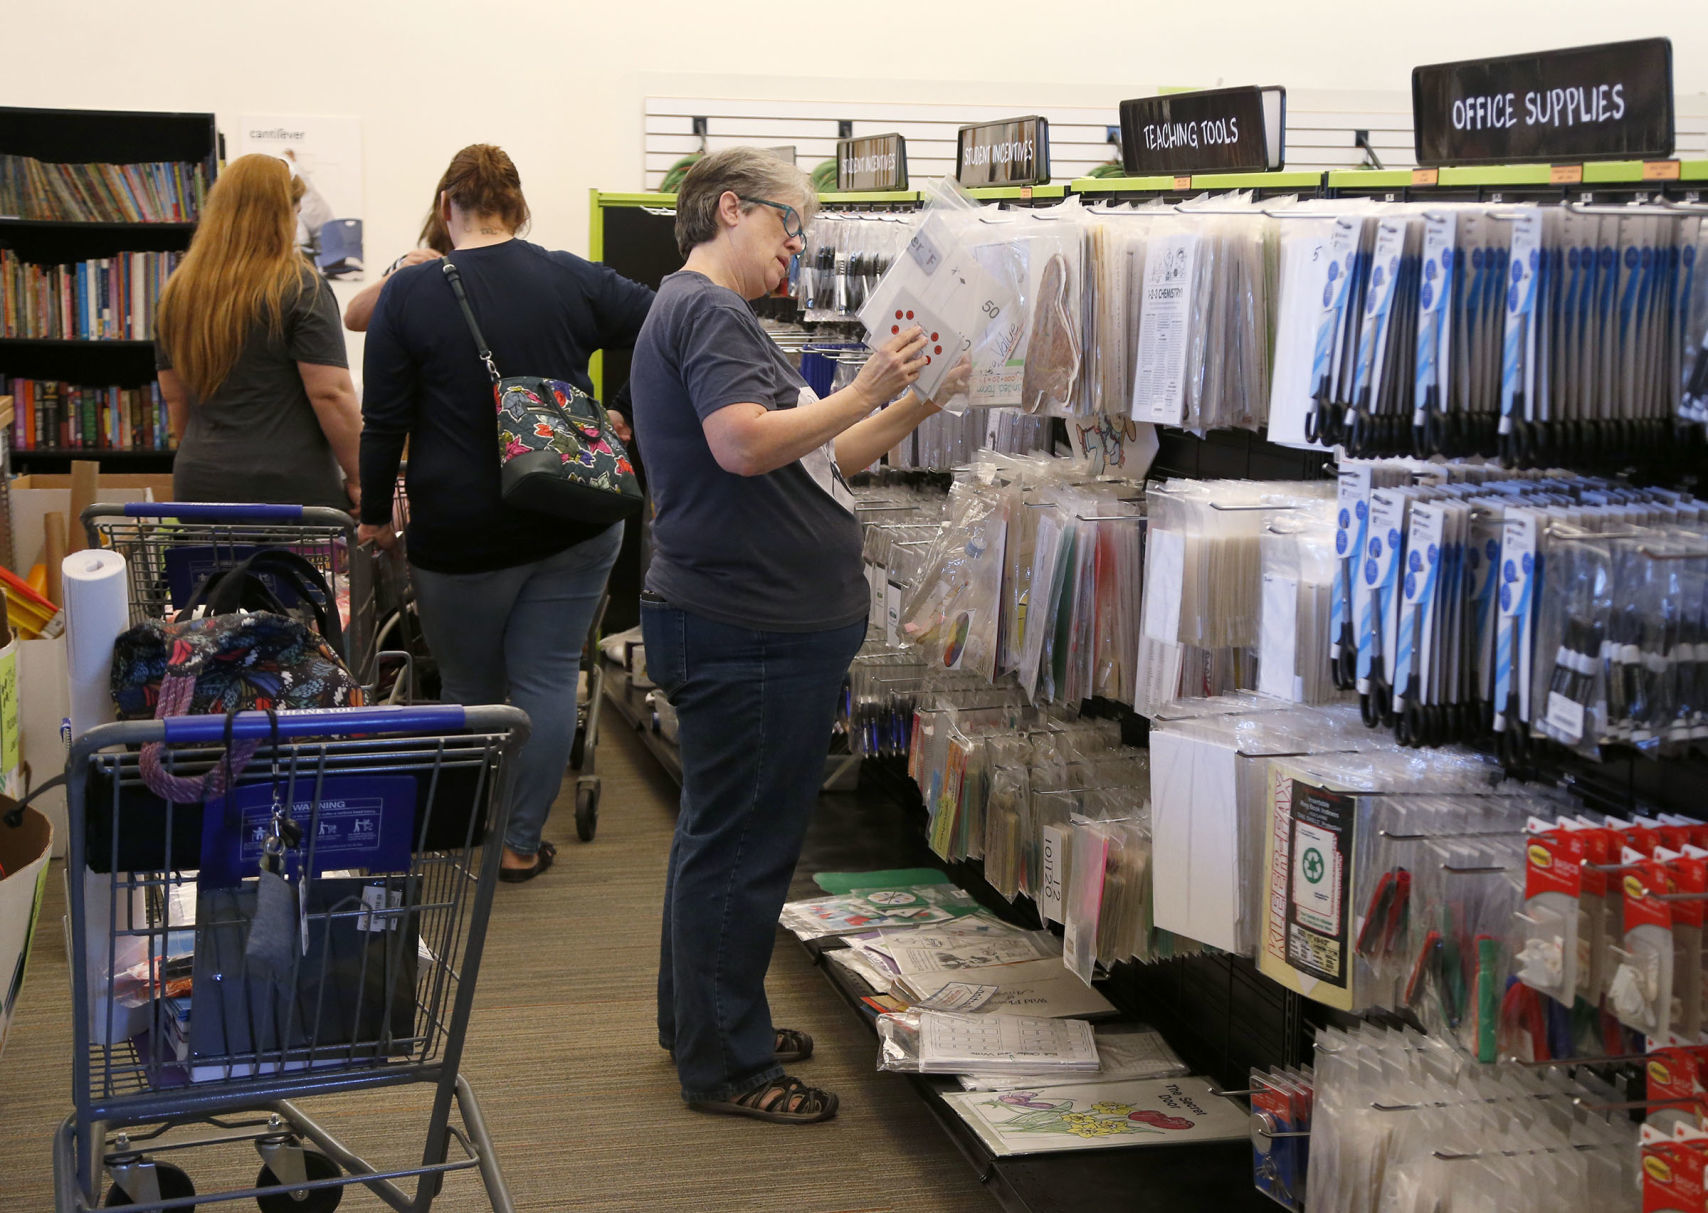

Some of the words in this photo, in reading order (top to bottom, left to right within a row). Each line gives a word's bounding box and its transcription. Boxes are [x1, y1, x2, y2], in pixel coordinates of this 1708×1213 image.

[1452, 92, 1517, 130] OFFICE
[1525, 83, 1625, 127] SUPPLIES
[249, 128, 305, 140] cantilever
[1143, 121, 1199, 150] TEACHING
[1200, 117, 1238, 145] TOOLS
[964, 145, 991, 166] STUDENT
[992, 139, 1033, 164] INCENTIVES
[842, 158, 865, 174] STUDENT
[865, 153, 896, 173] INCENTIVES
[981, 300, 1000, 319] 50
[278, 708, 323, 717] THANK
[328, 706, 356, 714] YOU
[293, 800, 346, 812] WANING
[1268, 769, 1295, 961] KLEER-FAX
[1158, 1094, 1181, 1109] Door
[1165, 1084, 1183, 1096] The
[1179, 1096, 1207, 1116] Secret
